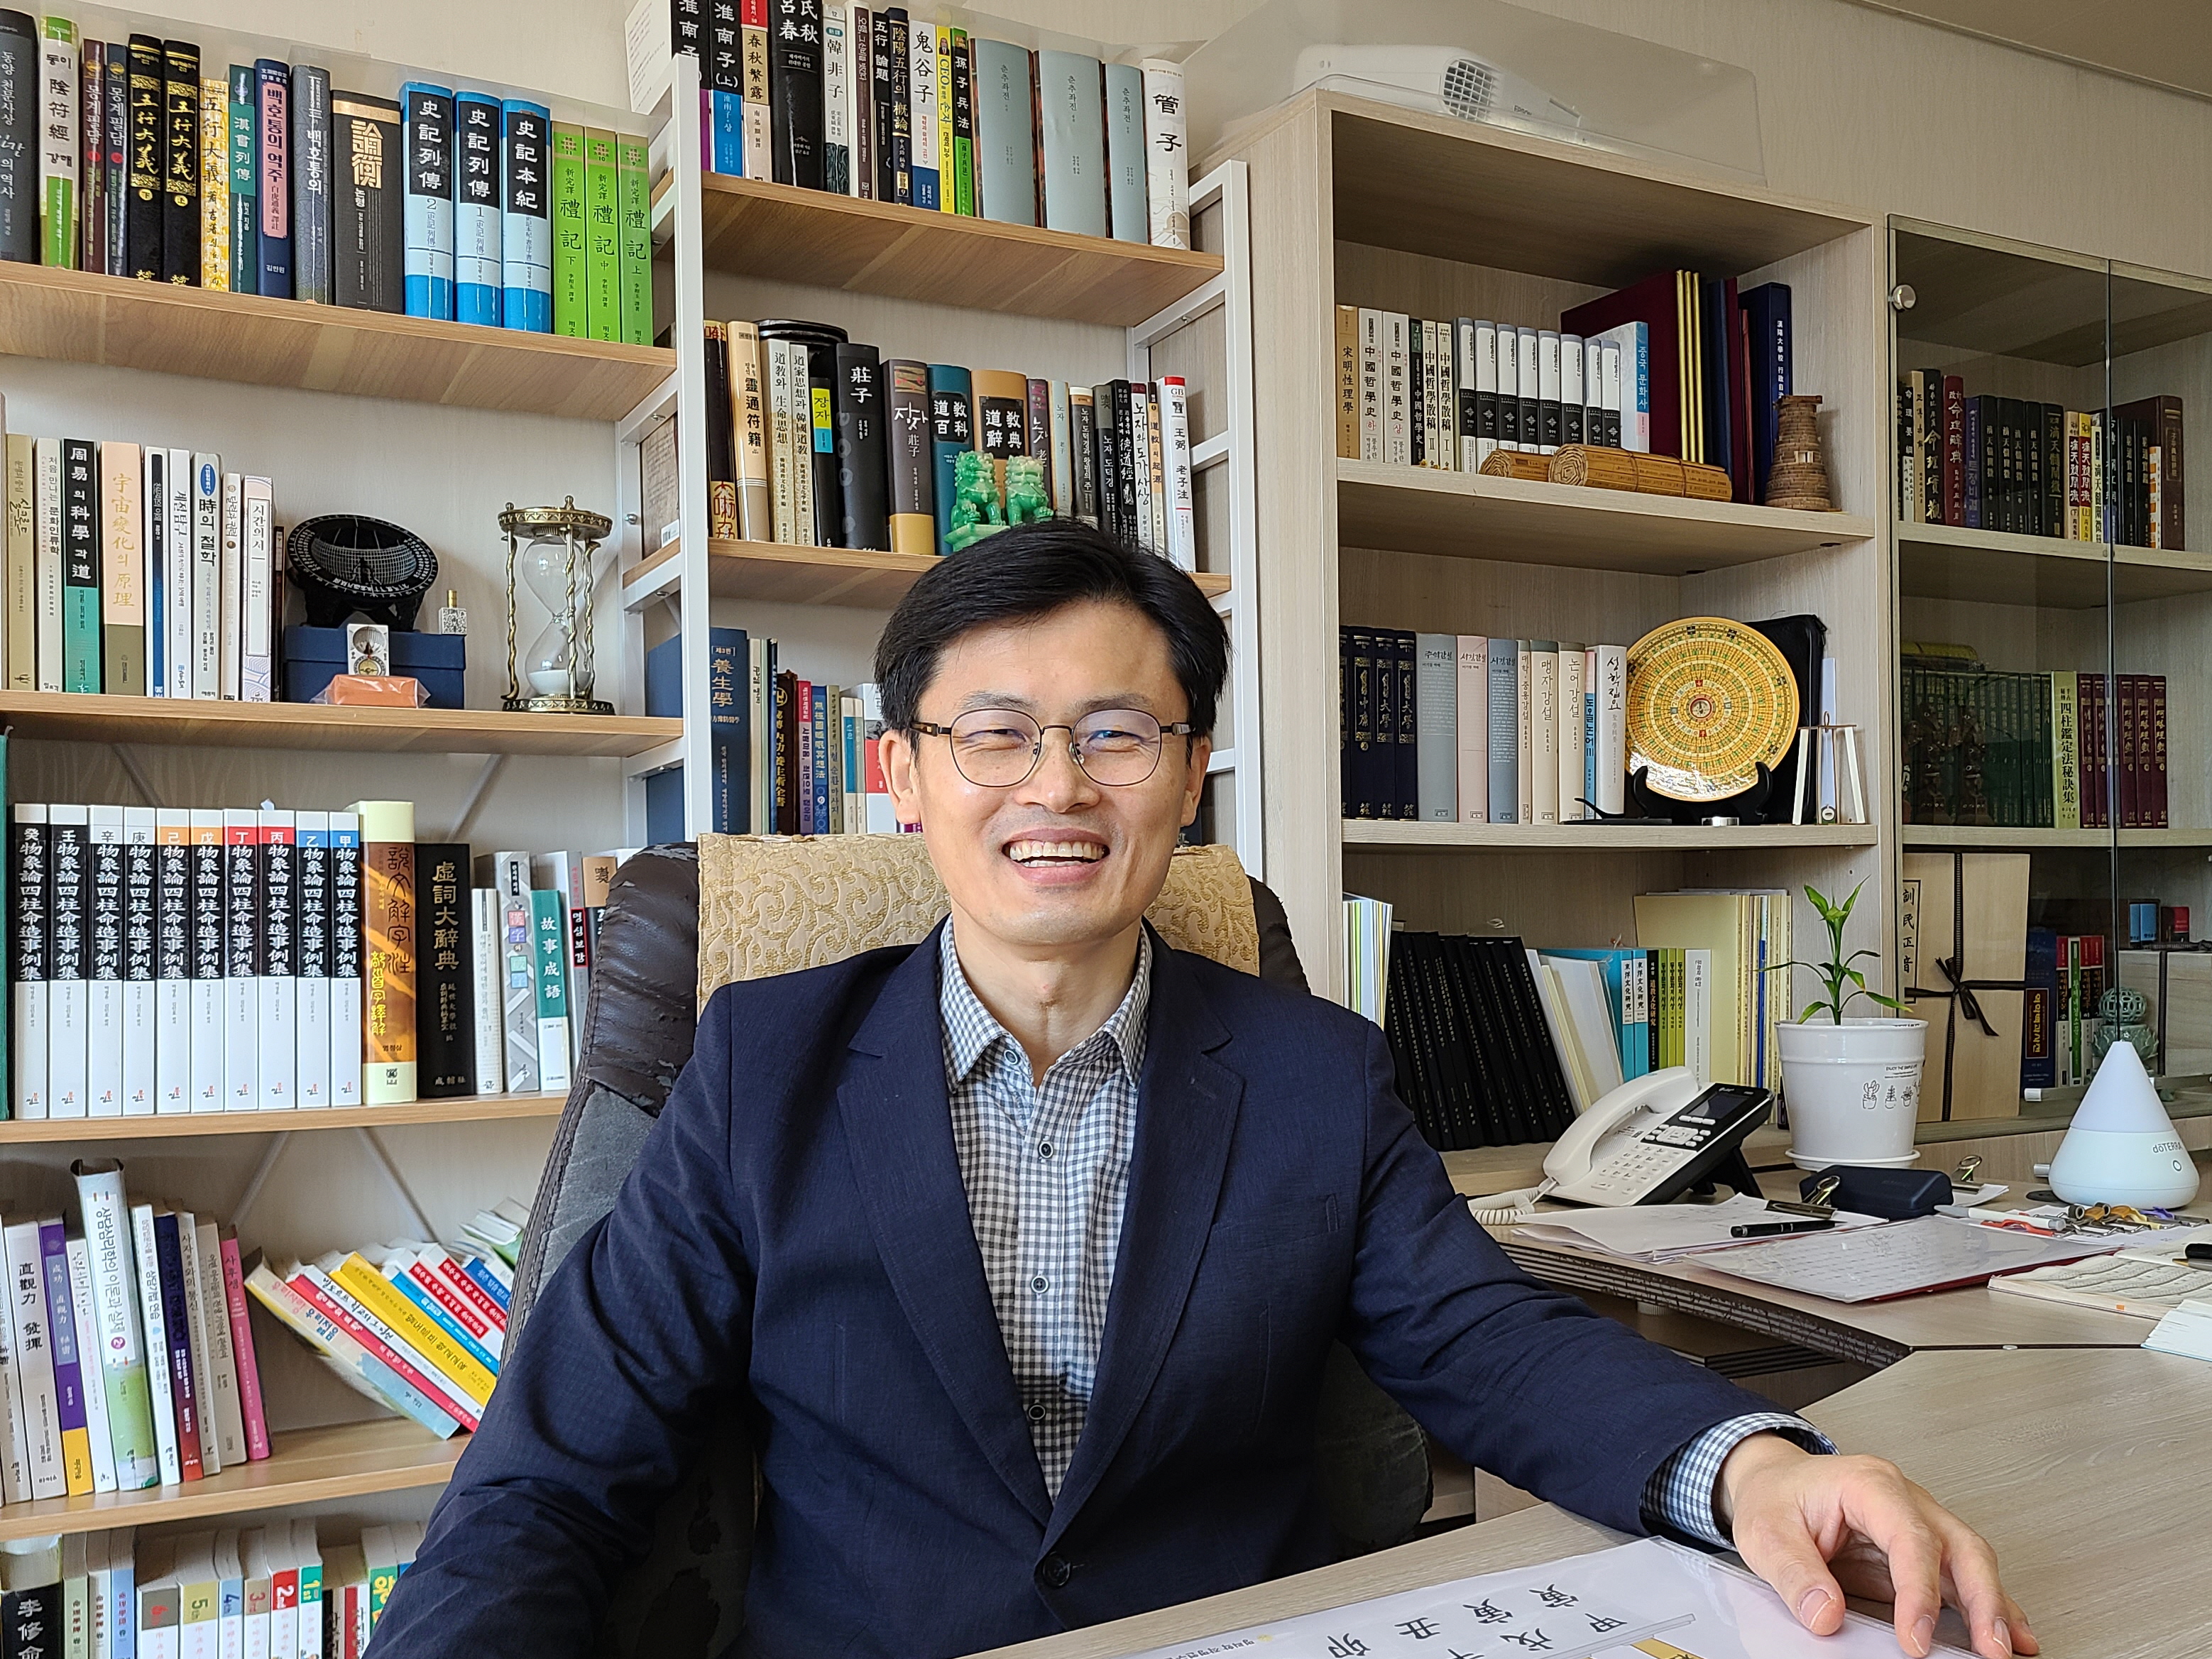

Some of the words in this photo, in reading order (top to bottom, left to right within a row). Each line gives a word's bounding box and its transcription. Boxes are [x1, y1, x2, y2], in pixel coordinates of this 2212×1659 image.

[779, 19, 819, 44] 春秋
[875, 20, 888, 47] 五行
[748, 34, 765, 100] 春秋繁露
[827, 39, 843, 98] 韓非子
[892, 27, 907, 99] 陰陽五行의
[913, 31, 934, 104] 鬼谷子
[955, 56, 970, 129] 孫子兵法
[1000, 64, 1009, 101] 춘추좌전
[1068, 75, 1077, 111] 춘추좌전
[108, 87, 126, 146] 몽계필담
[267, 89, 283, 149] 백호통의
[1122, 87, 1131, 123] 춘추좌전
[1153, 93, 1183, 152] 管子
[132, 94, 159, 175] 五行大義
[169, 101, 195, 181] 五行大義
[234, 116, 251, 181] 漢書列傳
[418, 100, 442, 190] 史記列傳
[268, 153, 283, 182] 역주
[351, 119, 384, 189] 論衡
[468, 109, 491, 197] 史記列傳
[515, 120, 538, 209] 史記本紀
[427, 198, 437, 210] 2
[476, 207, 484, 217] 1
[559, 199, 582, 250] 禮記
[593, 204, 615, 256] 禮記
[625, 209, 647, 260] 禮記
[566, 256, 576, 265] 下
[600, 260, 609, 271] 中
[631, 265, 642, 275] 上
[1638, 346, 1647, 371] 중국
[794, 355, 806, 410] 道家思想과
[850, 367, 872, 403] 莊子
[1342, 346, 1354, 415] 宋明性理學
[1364, 346, 1376, 419] 中國哲學史
[1390, 351, 1403, 422] 中國哲學史
[1638, 375, 1648, 410] 문화사
[776, 395, 788, 444] 生命思想
[814, 397, 829, 422] 장자
[1056, 404, 1066, 422] 노자
[1081, 407, 1090, 425] 노자
[1134, 402, 1149, 444] 노자와
[1414, 390, 1424, 444] 中國哲學史
[934, 420, 968, 437] 百科
[985, 429, 1023, 449] 辭典
[1102, 434, 1113, 455] 노자
[1173, 427, 1186, 450] 王弼
[48, 456, 58, 473] 처음
[70, 447, 88, 500] 周易의
[1104, 459, 1115, 488] 도덕경
[1135, 448, 1151, 506] 도가사상
[1176, 464, 1189, 500] 老子注
[48, 476, 58, 502] 만나는
[48, 506, 60, 555] 문화인류학
[70, 505, 90, 559] 科學과
[111, 473, 135, 566] 宇宙變化의
[199, 498, 217, 531] 時의
[253, 505, 265, 535] 시간의
[200, 536, 217, 567] 철학
[253, 540, 265, 552] 시
[72, 564, 92, 579] 道
[113, 574, 136, 608] 原理
[711, 658, 735, 708] 養生學
[1540, 659, 1553, 721] 맹자강설
[1567, 657, 1580, 718] 논어강설
[1606, 656, 1621, 711] 성학집요
[2060, 702, 2074, 804] 四柱鑑定法秘訣集
[831, 788, 839, 814] 마사지
[23, 828, 40, 842] 癸
[61, 831, 76, 843] 壬
[101, 831, 114, 843] 辛
[132, 831, 146, 844] 庚
[168, 832, 180, 843] 己
[199, 832, 214, 844] 戊
[236, 831, 248, 843] 丁
[270, 831, 284, 843] 丙
[307, 836, 319, 847] 乙
[339, 836, 353, 847] 甲
[432, 861, 459, 970] 虛詞大辭典
[1902, 887, 1915, 973] 訓民正音
[572, 911, 585, 964] 명심보감
[540, 916, 562, 999] 故事成語
[18, 1262, 37, 1305] 直觀力
[225, 1255, 239, 1289] 사후생
[23, 1322, 43, 1351] 發揮
[1462, 1598, 1515, 1625] 寅
[1527, 1583, 1580, 1610] 寅
[1582, 1611, 1628, 1633] 甲
